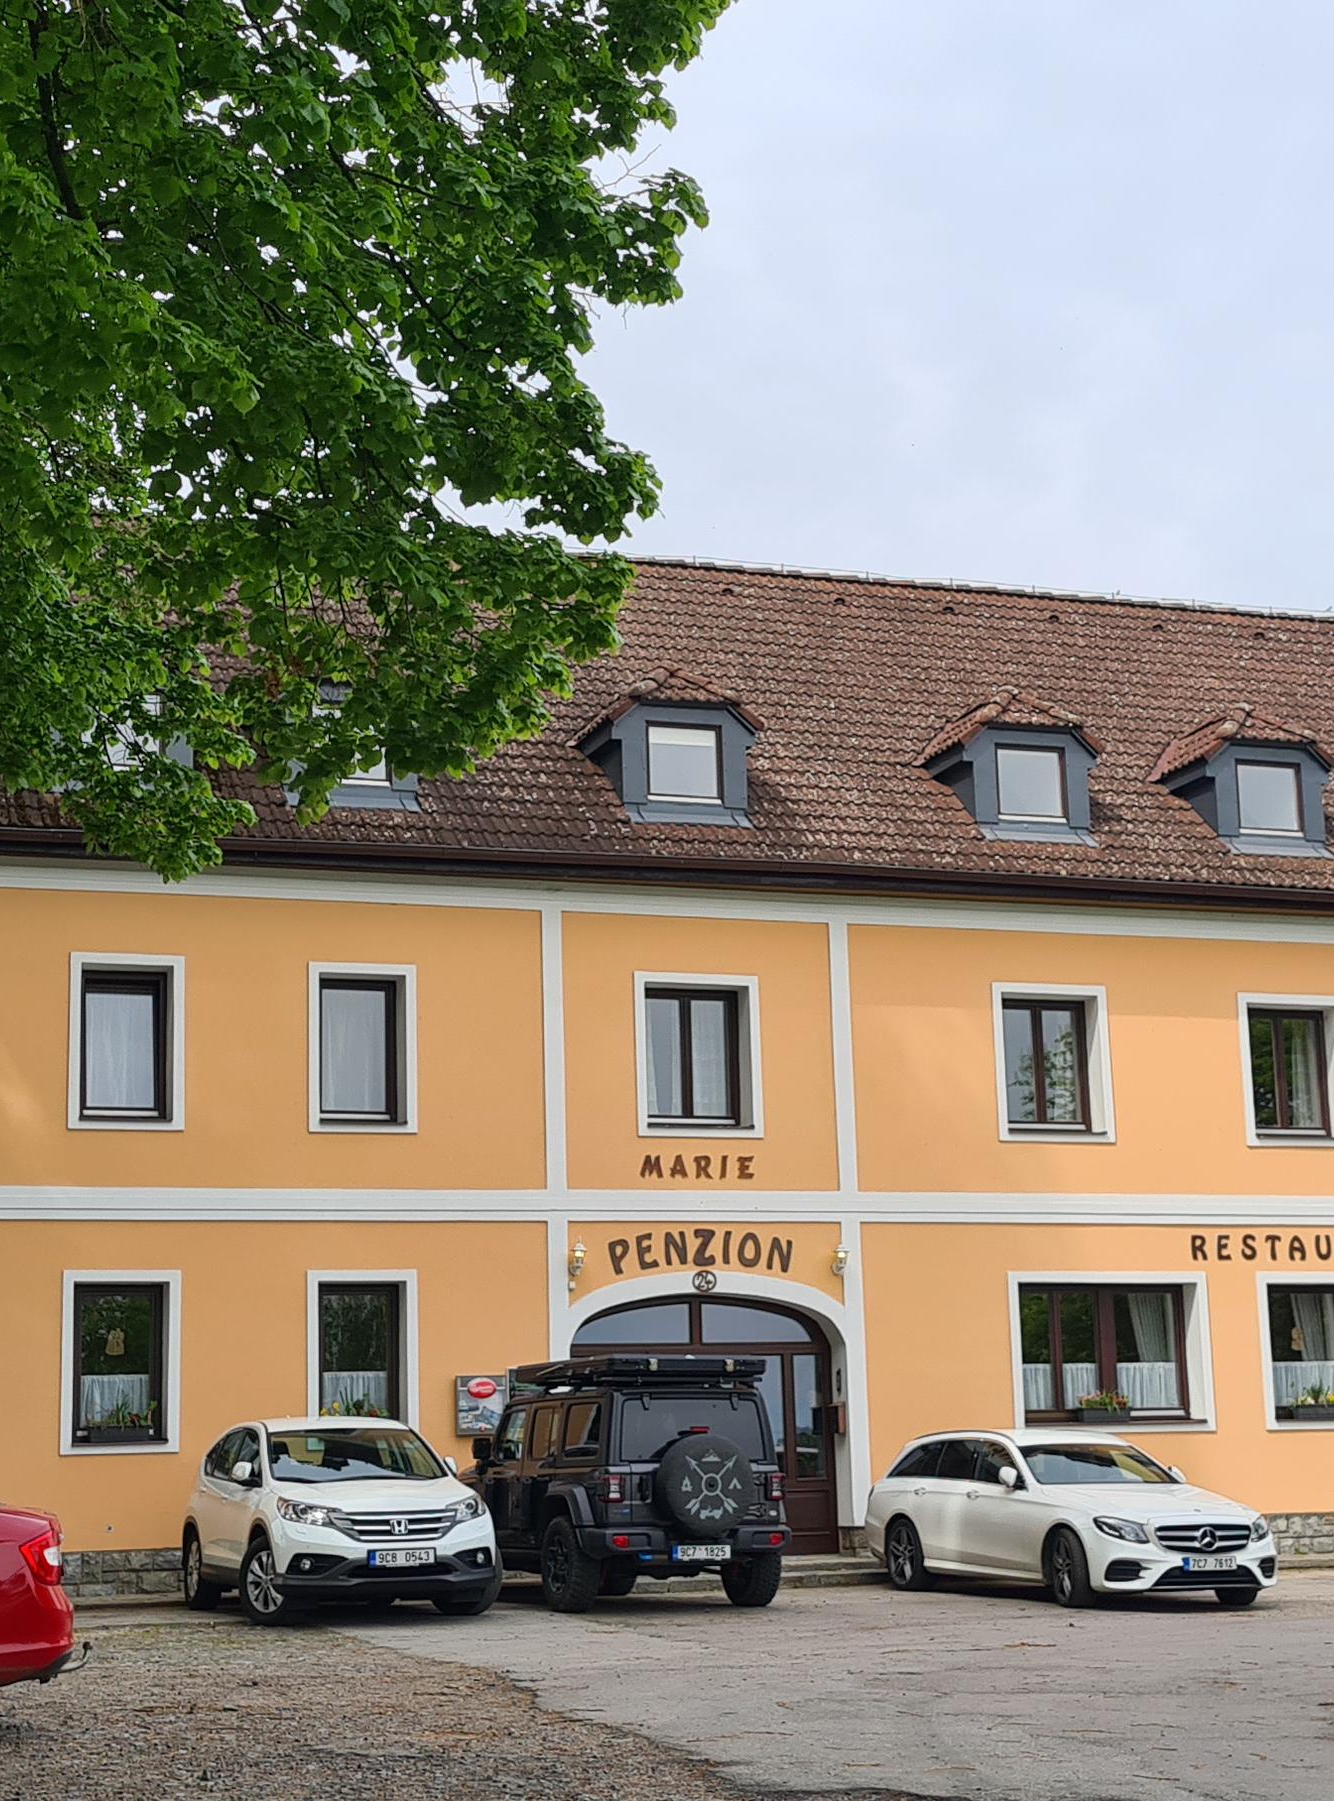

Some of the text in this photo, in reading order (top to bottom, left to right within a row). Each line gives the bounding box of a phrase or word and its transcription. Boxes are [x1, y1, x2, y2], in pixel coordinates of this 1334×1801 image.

[639, 1154, 756, 1180] MARIE
[608, 1228, 793, 1275] PENZION
[696, 1272, 713, 1290] 24
[405, 1550, 430, 1562] 0543
[680, 1546, 727, 1557] 9C7 1825
[1192, 1558, 1208, 1569] 7C7
